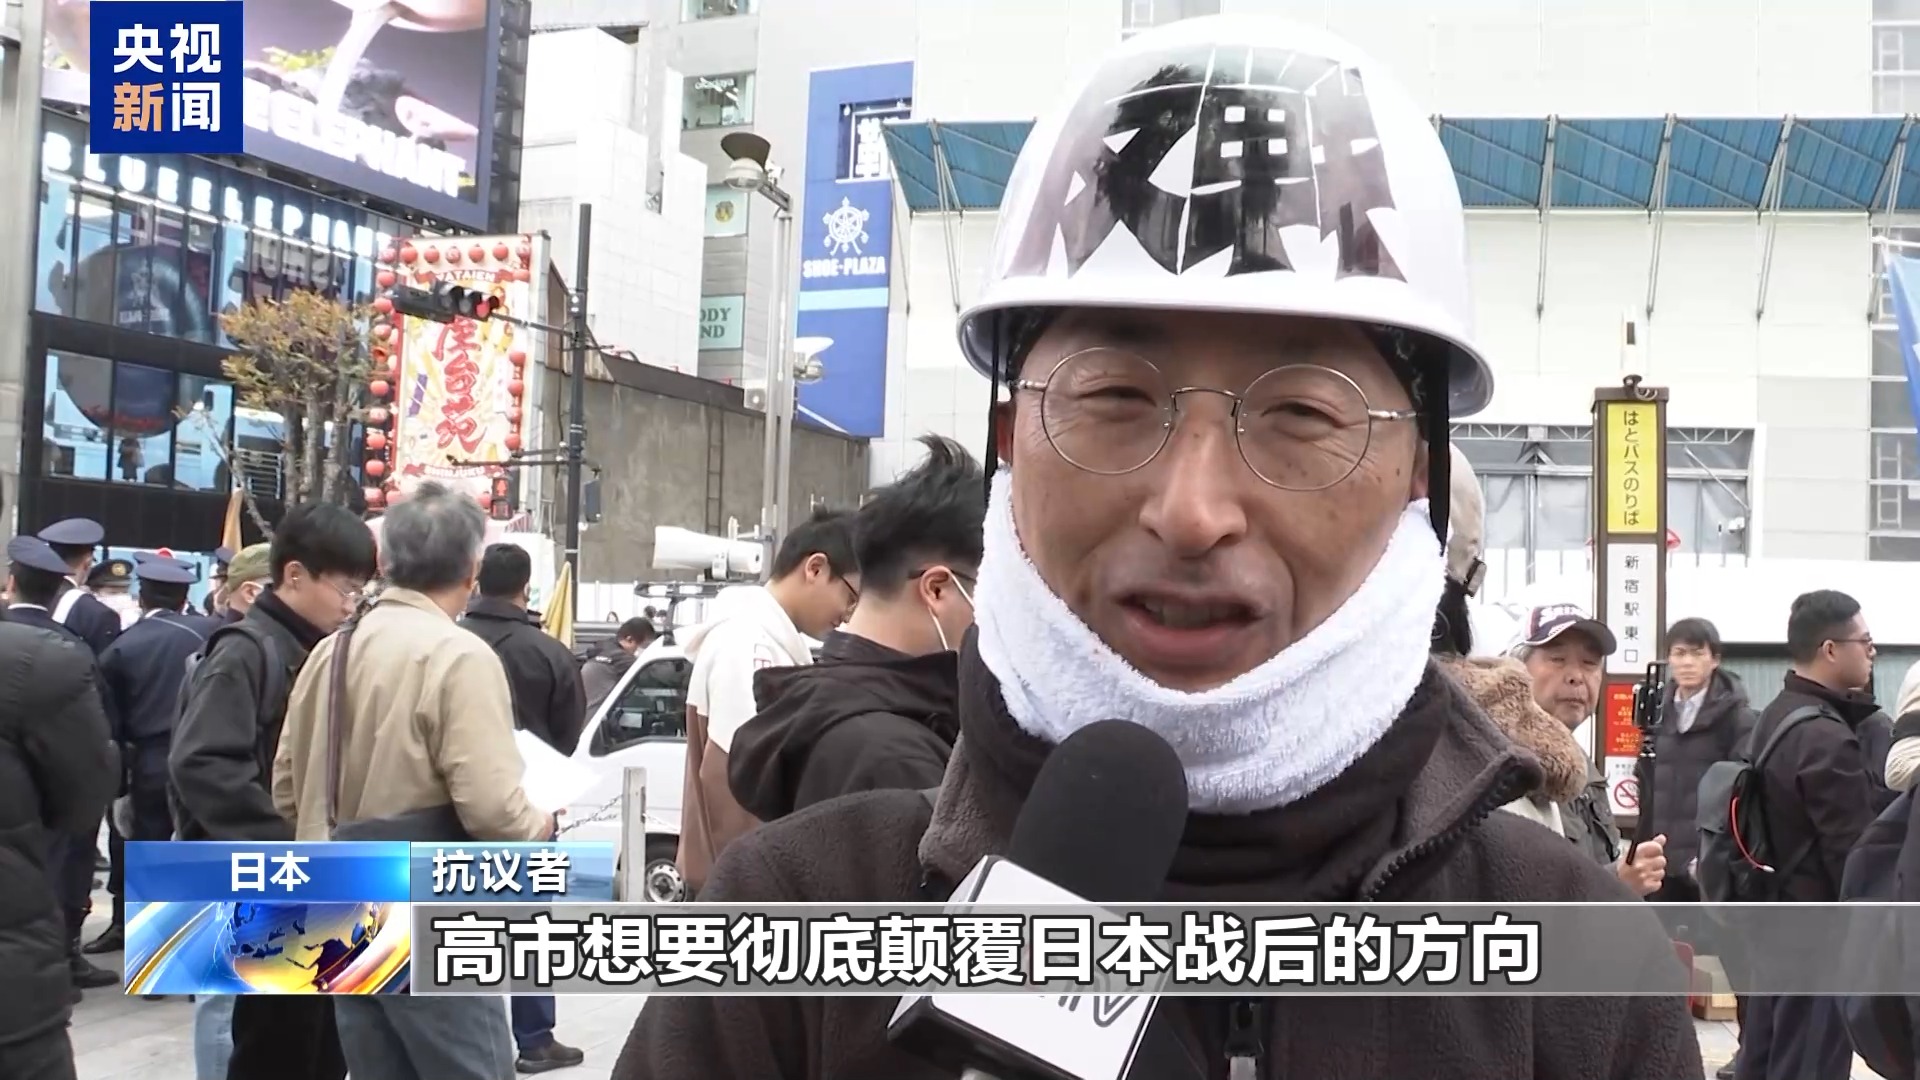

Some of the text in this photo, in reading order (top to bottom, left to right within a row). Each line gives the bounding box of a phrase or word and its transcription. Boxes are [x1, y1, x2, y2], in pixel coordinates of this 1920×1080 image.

[803, 256, 886, 279] SHOE-PLAZA
[1623, 410, 1640, 526] はとバスのりば
[1624, 555, 1639, 663] 新宿駅東口
